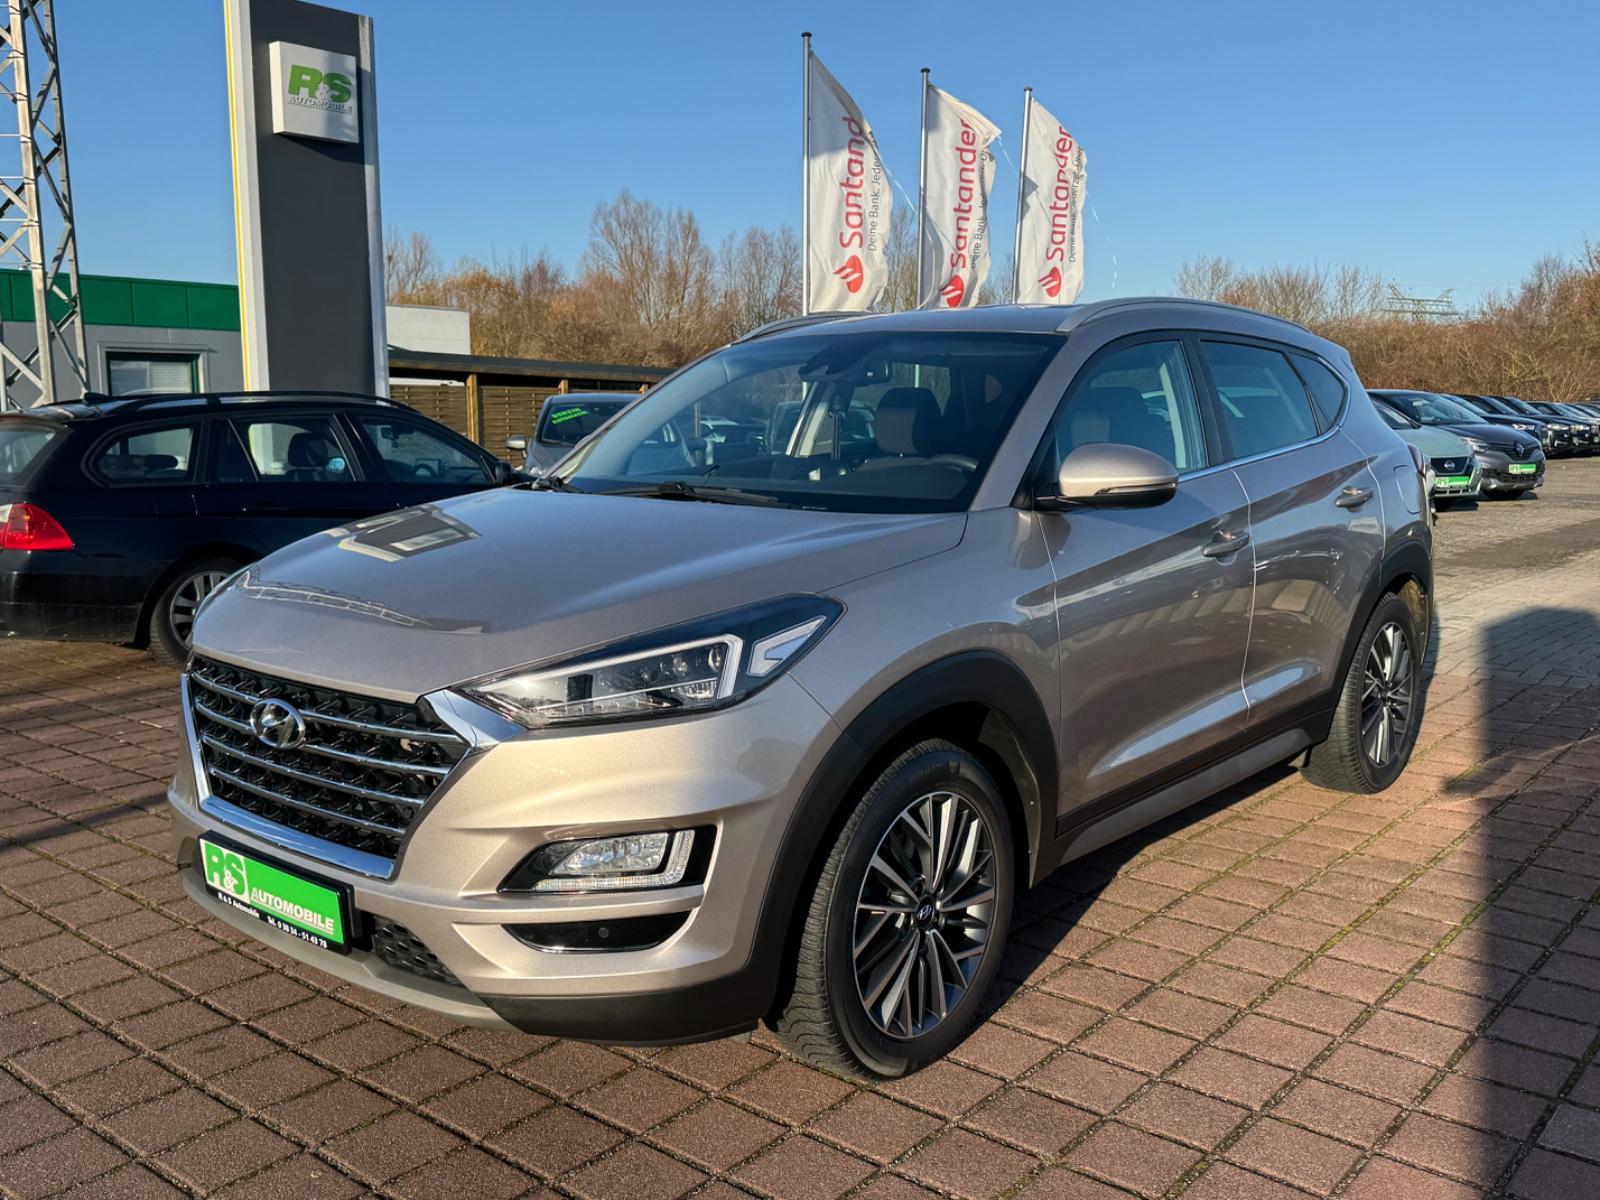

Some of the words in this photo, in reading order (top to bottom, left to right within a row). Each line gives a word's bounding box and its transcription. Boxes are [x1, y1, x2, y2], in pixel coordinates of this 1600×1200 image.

[288, 64, 352, 103] R&S
[839, 116, 864, 248] Santand
[872, 156, 882, 185] Jede
[950, 118, 977, 268] Santander
[1046, 126, 1073, 262] Santander
[868, 221, 878, 251] Deine
[204, 841, 246, 896] R&S
[251, 887, 334, 931] AUTOMOBILE
